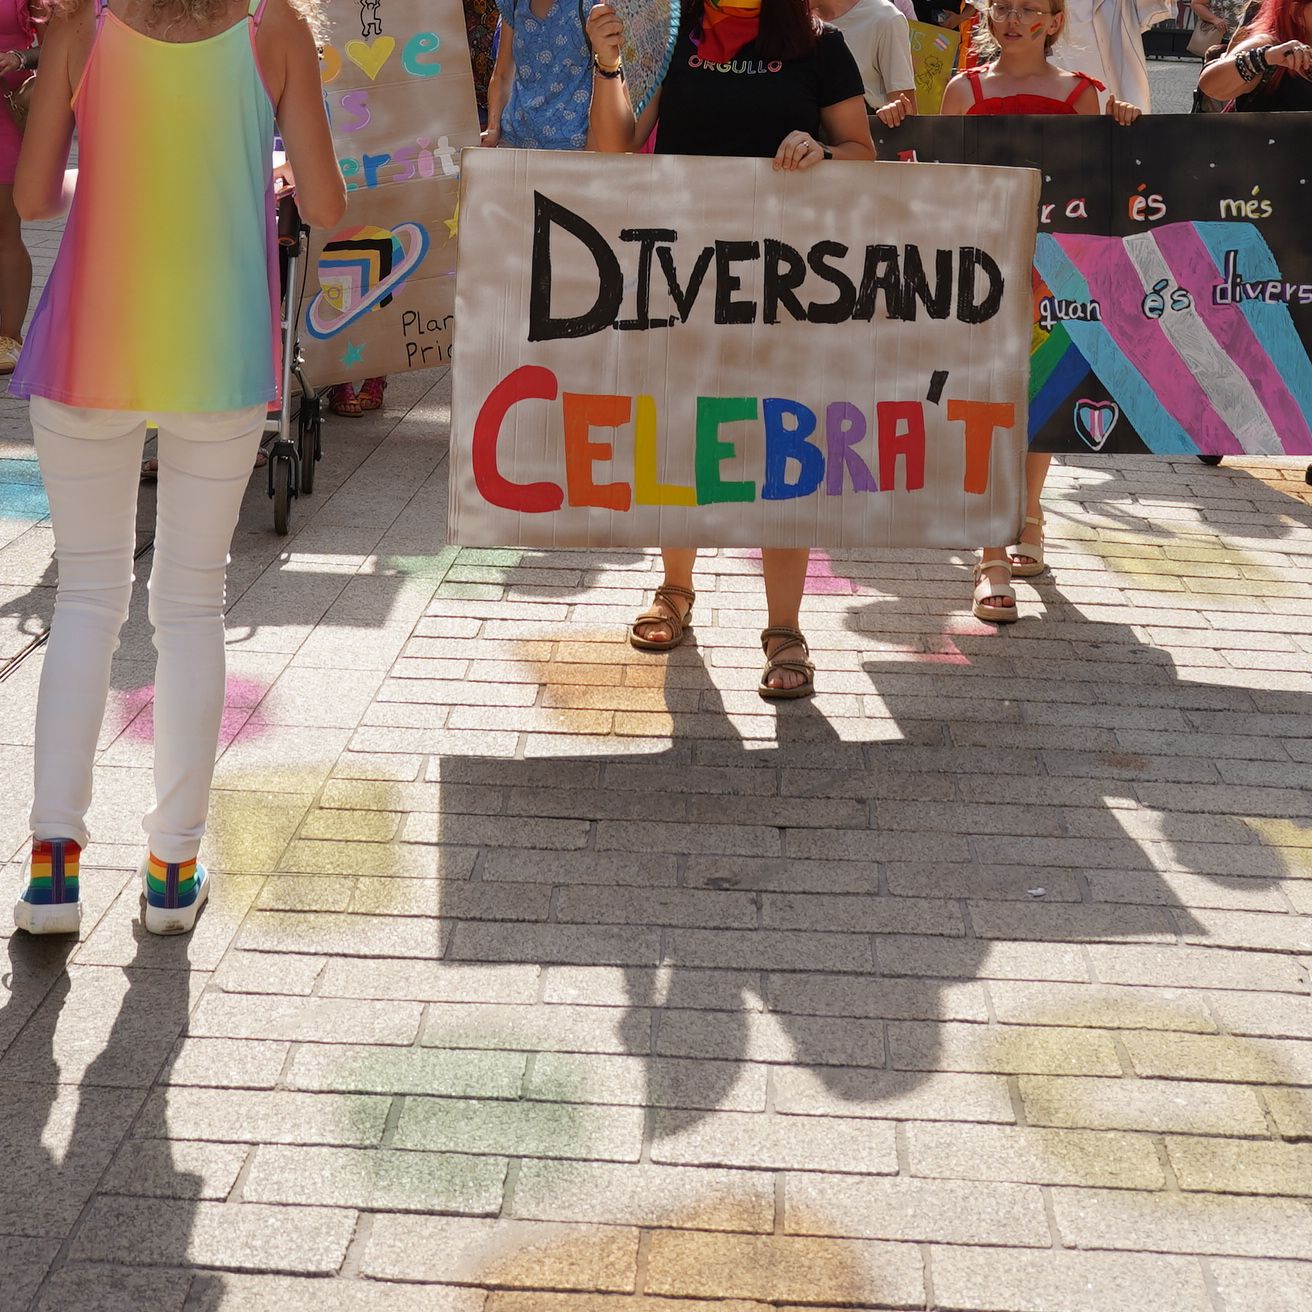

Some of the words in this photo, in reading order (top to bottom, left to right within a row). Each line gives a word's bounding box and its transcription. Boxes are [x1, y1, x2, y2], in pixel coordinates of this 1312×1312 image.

[688, 54, 783, 75] ORGULLO
[1220, 185, 1273, 219] més
[527, 189, 1005, 342] DIVERSAND
[1039, 296, 1103, 332] quan
